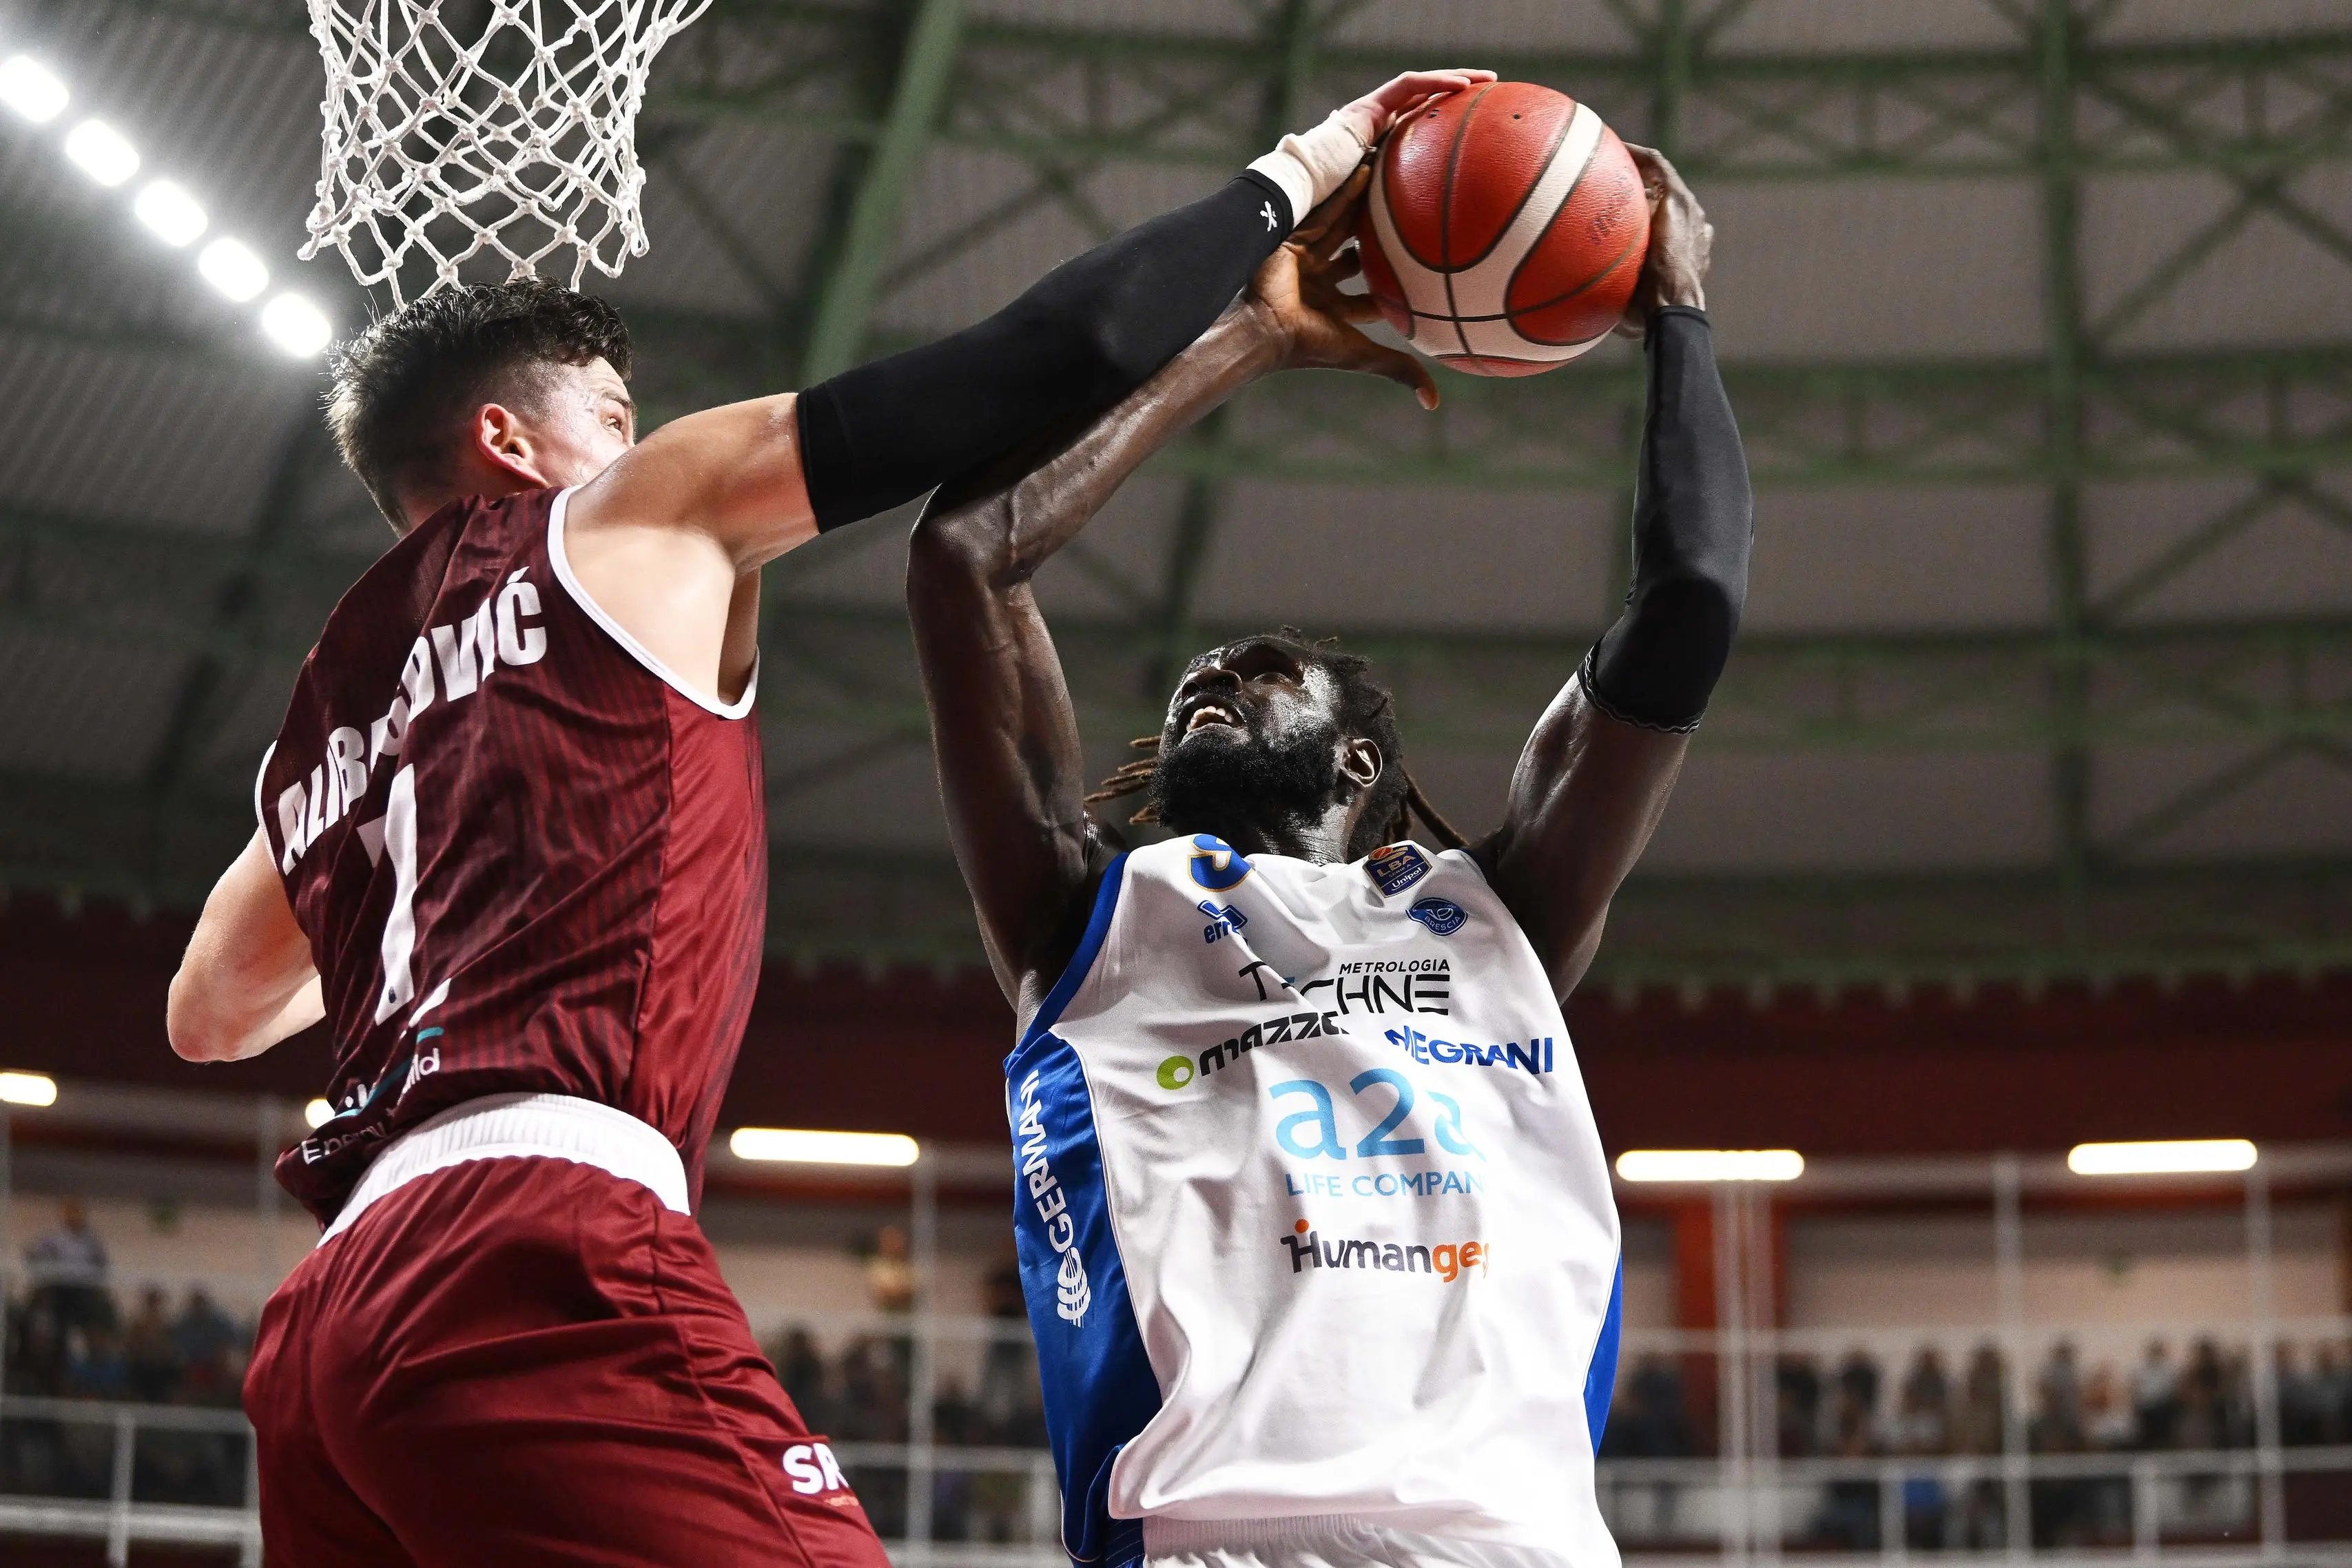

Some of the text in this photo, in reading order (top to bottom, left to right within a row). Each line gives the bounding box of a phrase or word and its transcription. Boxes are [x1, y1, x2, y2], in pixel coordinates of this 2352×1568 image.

[1376, 854, 1417, 878] LBA
[1391, 866, 1423, 889] Unipol
[1423, 916, 1461, 931] BRESCIA
[1339, 959, 1451, 975] METROLOGIA
[1238, 960, 1451, 1016] TCHNE
[1268, 1068, 1487, 1162] a2a
[1018, 1069, 1074, 1254] GERMANI
[1285, 1171, 1485, 1197] LIFE COMPAN
